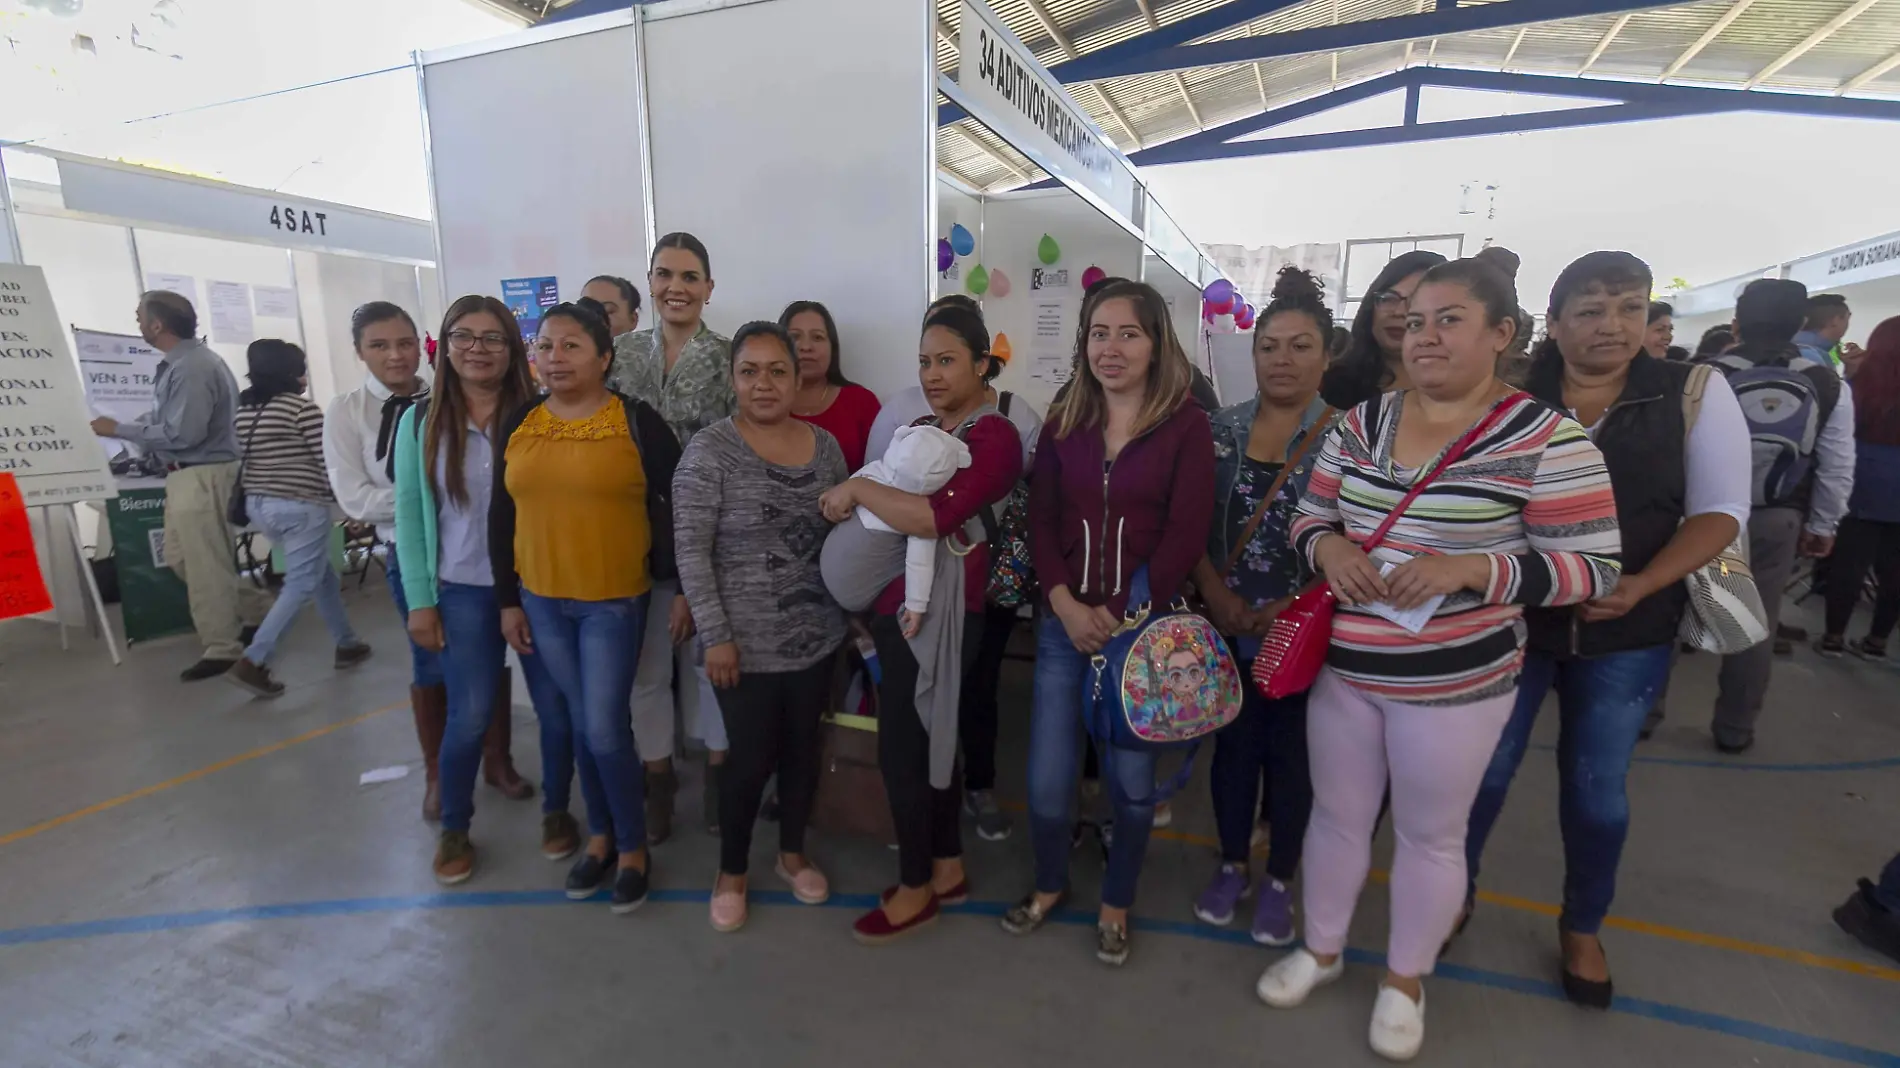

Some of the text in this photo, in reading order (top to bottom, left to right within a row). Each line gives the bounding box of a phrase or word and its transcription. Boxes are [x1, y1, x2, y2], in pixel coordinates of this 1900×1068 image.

[979, 28, 995, 87] 34
[996, 47, 1046, 131] ADITIVOS
[270, 205, 326, 236] 4SAT
[89, 373, 117, 384] VEN
[120, 376, 128, 384] a
[0, 425, 55, 437] IA EN
[14, 440, 73, 452] COMP.
